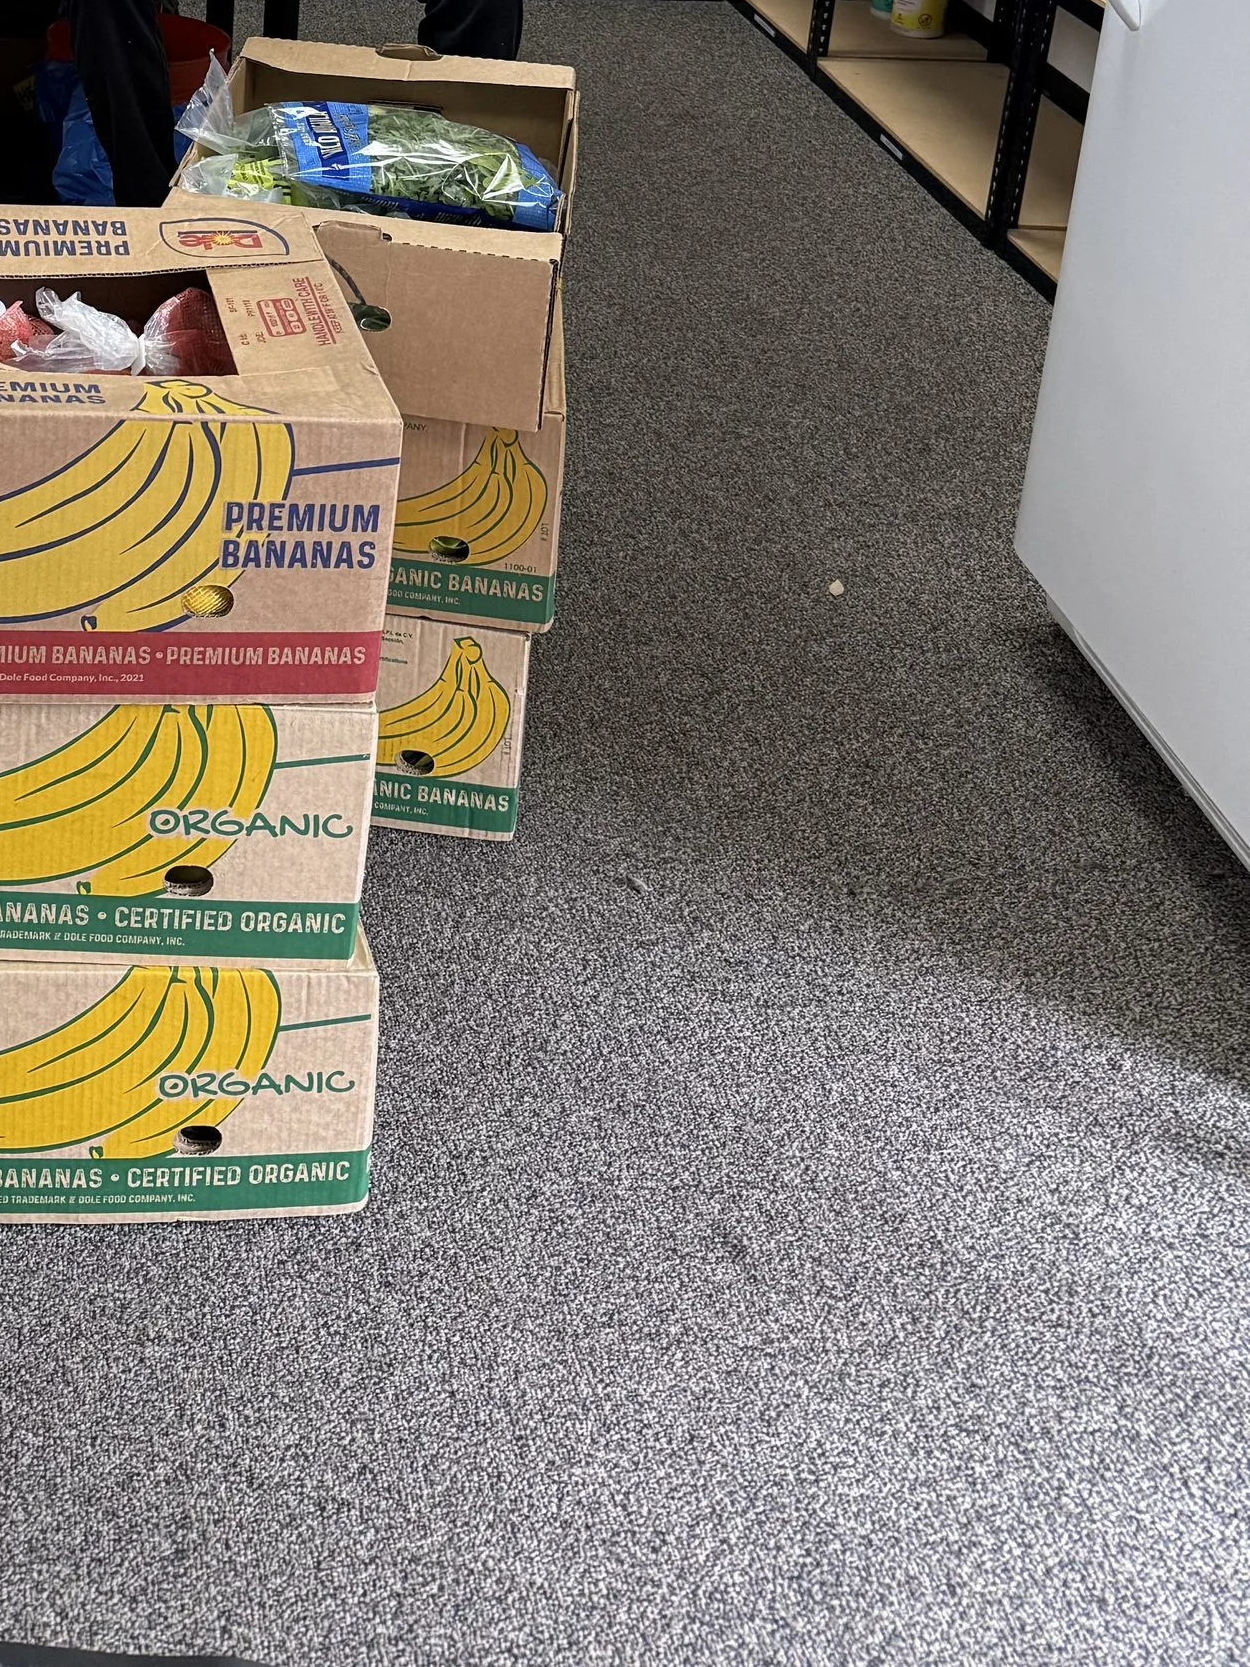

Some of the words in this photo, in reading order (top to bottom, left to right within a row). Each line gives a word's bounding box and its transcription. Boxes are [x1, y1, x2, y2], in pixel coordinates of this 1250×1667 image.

[178, 232, 263, 250] Dole
[223, 502, 379, 534] PREMIUM
[220, 539, 376, 570] BANANAS
[504, 562, 537, 573] 1100-01
[449, 574, 544, 602] BANANAS
[52, 646, 151, 665] BANANAS
[166, 646, 263, 665] PREMIUM
[267, 646, 366, 666] BANANAS
[23, 673, 47, 682] Food
[49, 674, 96, 683] Company,
[120, 674, 144, 682] 2021
[417, 785, 509, 812] BANANAS
[149, 808, 353, 839] ORGANIC
[115, 906, 233, 932] CERTIFIED
[240, 911, 346, 934] ORGANIC
[64, 931, 86, 942] DOLE
[89, 932, 114, 943] FOOD
[116, 934, 163, 945] COMPANY,
[166, 936, 186, 946] INC.
[159, 1071, 355, 1100] ORGANIC
[127, 1165, 241, 1188] CERTIFIED
[249, 1161, 350, 1185] ORGANIC
